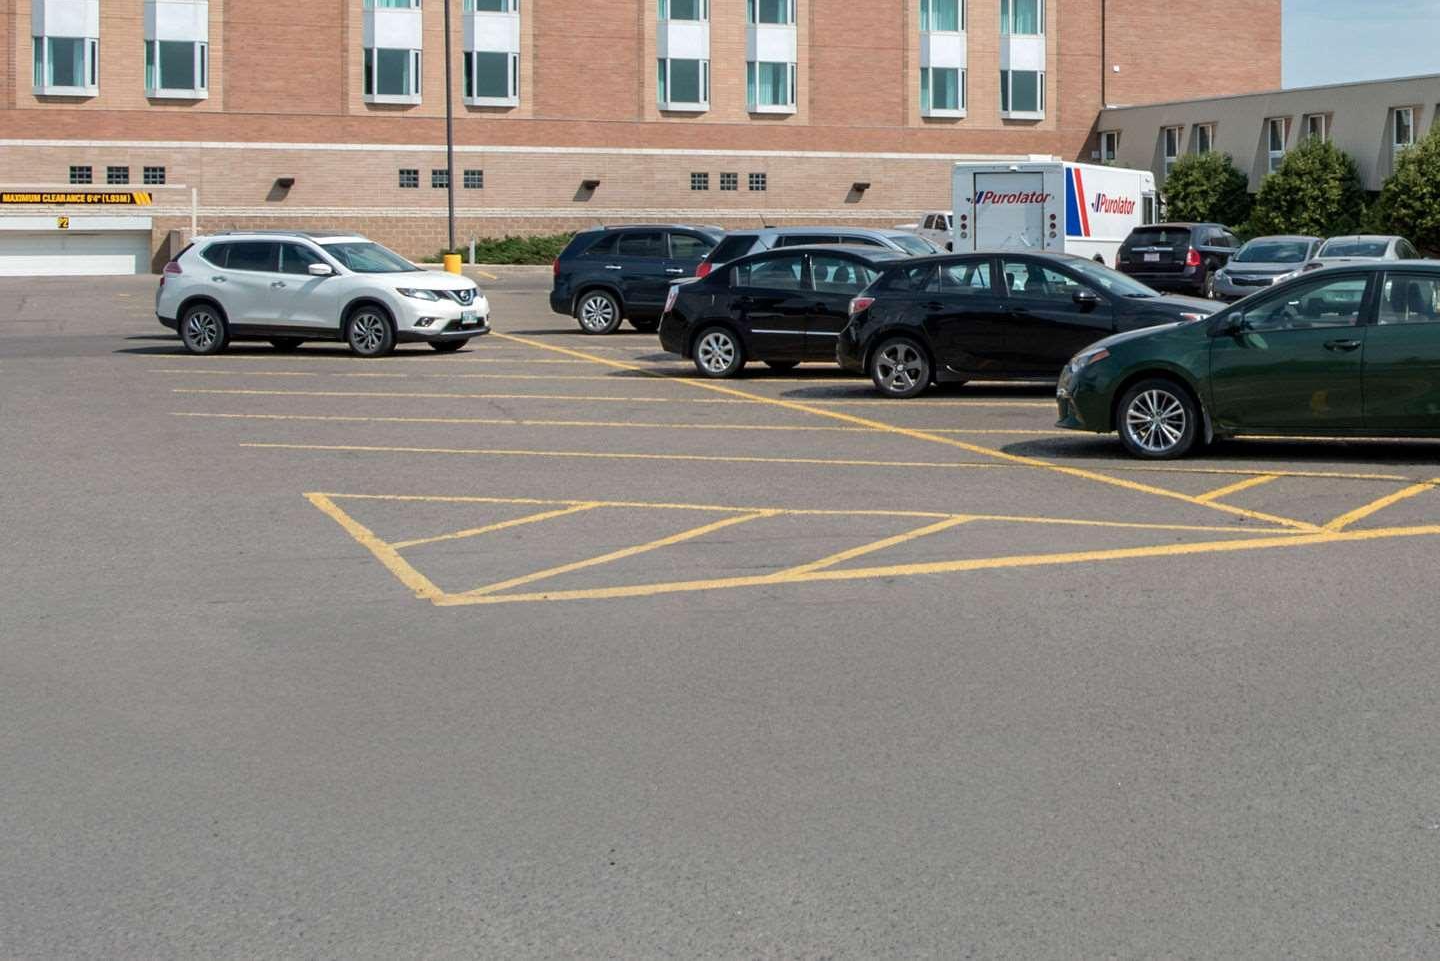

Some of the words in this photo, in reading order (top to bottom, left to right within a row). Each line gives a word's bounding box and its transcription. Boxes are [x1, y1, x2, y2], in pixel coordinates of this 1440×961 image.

[2, 193, 41, 202] MAXIMUM
[42, 193, 86, 203] CLEARANCE
[982, 191, 1051, 204] Purolator
[1100, 193, 1136, 215] Purolator
